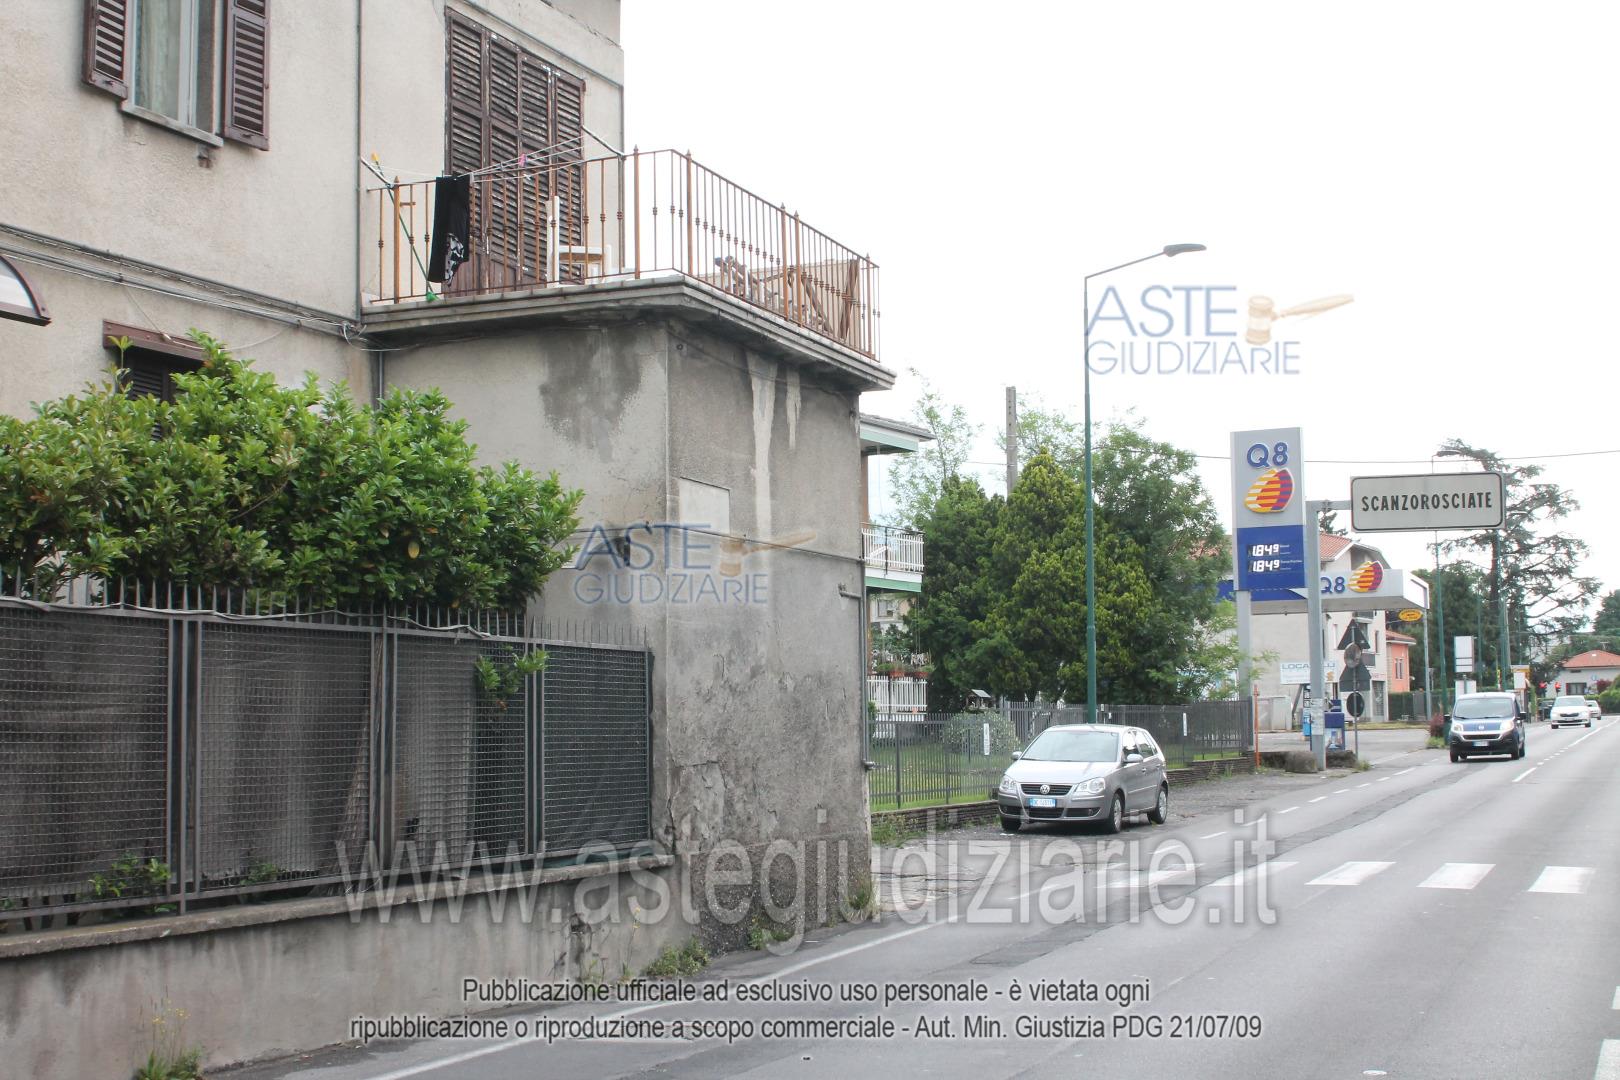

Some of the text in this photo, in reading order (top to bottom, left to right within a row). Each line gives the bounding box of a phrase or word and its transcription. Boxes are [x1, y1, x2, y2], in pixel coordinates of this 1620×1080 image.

[1247, 441, 1288, 467] Q8
[1362, 492, 1492, 512] SCANZOROSCIATE
[1319, 576, 1346, 594] Q8
